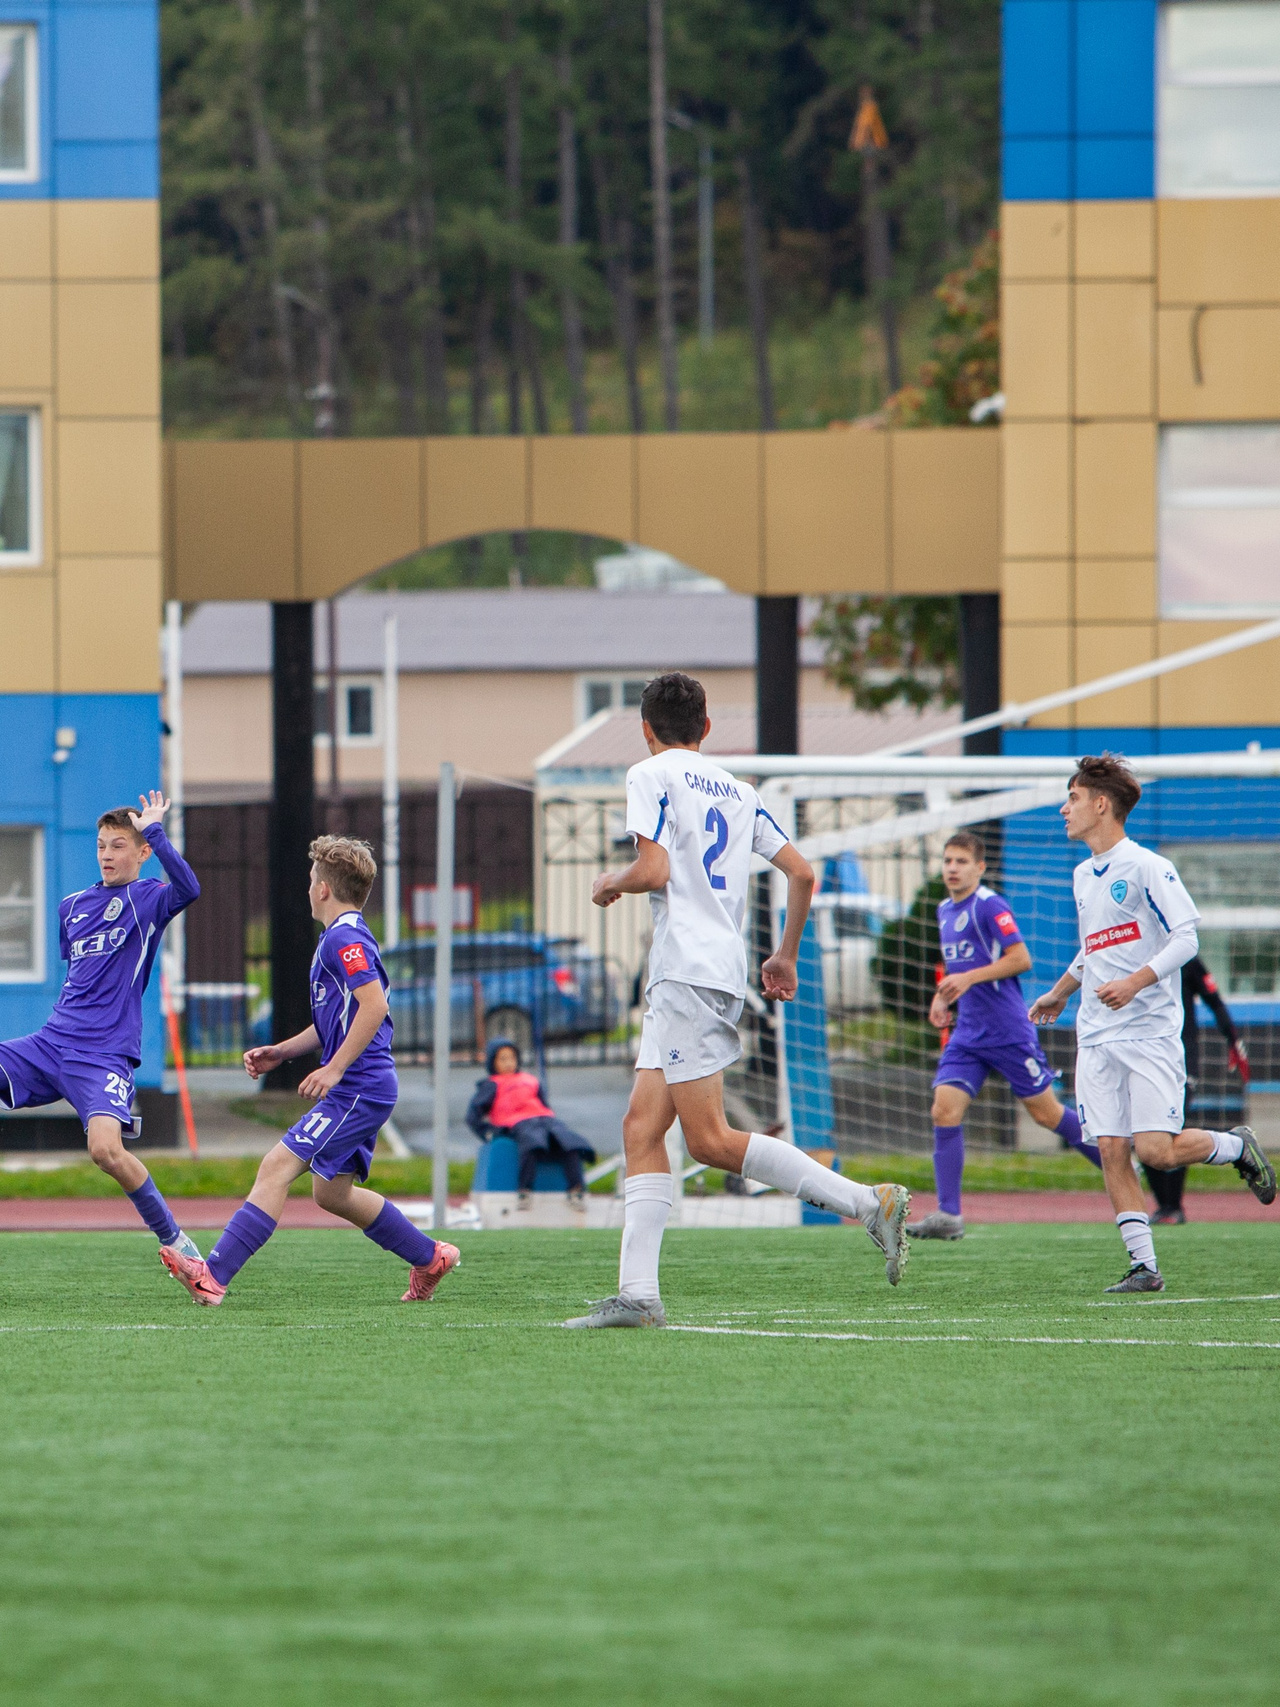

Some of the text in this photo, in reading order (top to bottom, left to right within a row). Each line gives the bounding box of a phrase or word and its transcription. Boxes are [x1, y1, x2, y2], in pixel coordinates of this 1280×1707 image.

[684, 771, 742, 802] САХАЛИН
[702, 806, 729, 890] 2
[1109, 926, 1135, 941] Банк
[104, 1072, 131, 1102] 25
[303, 1112, 333, 1139] 11
